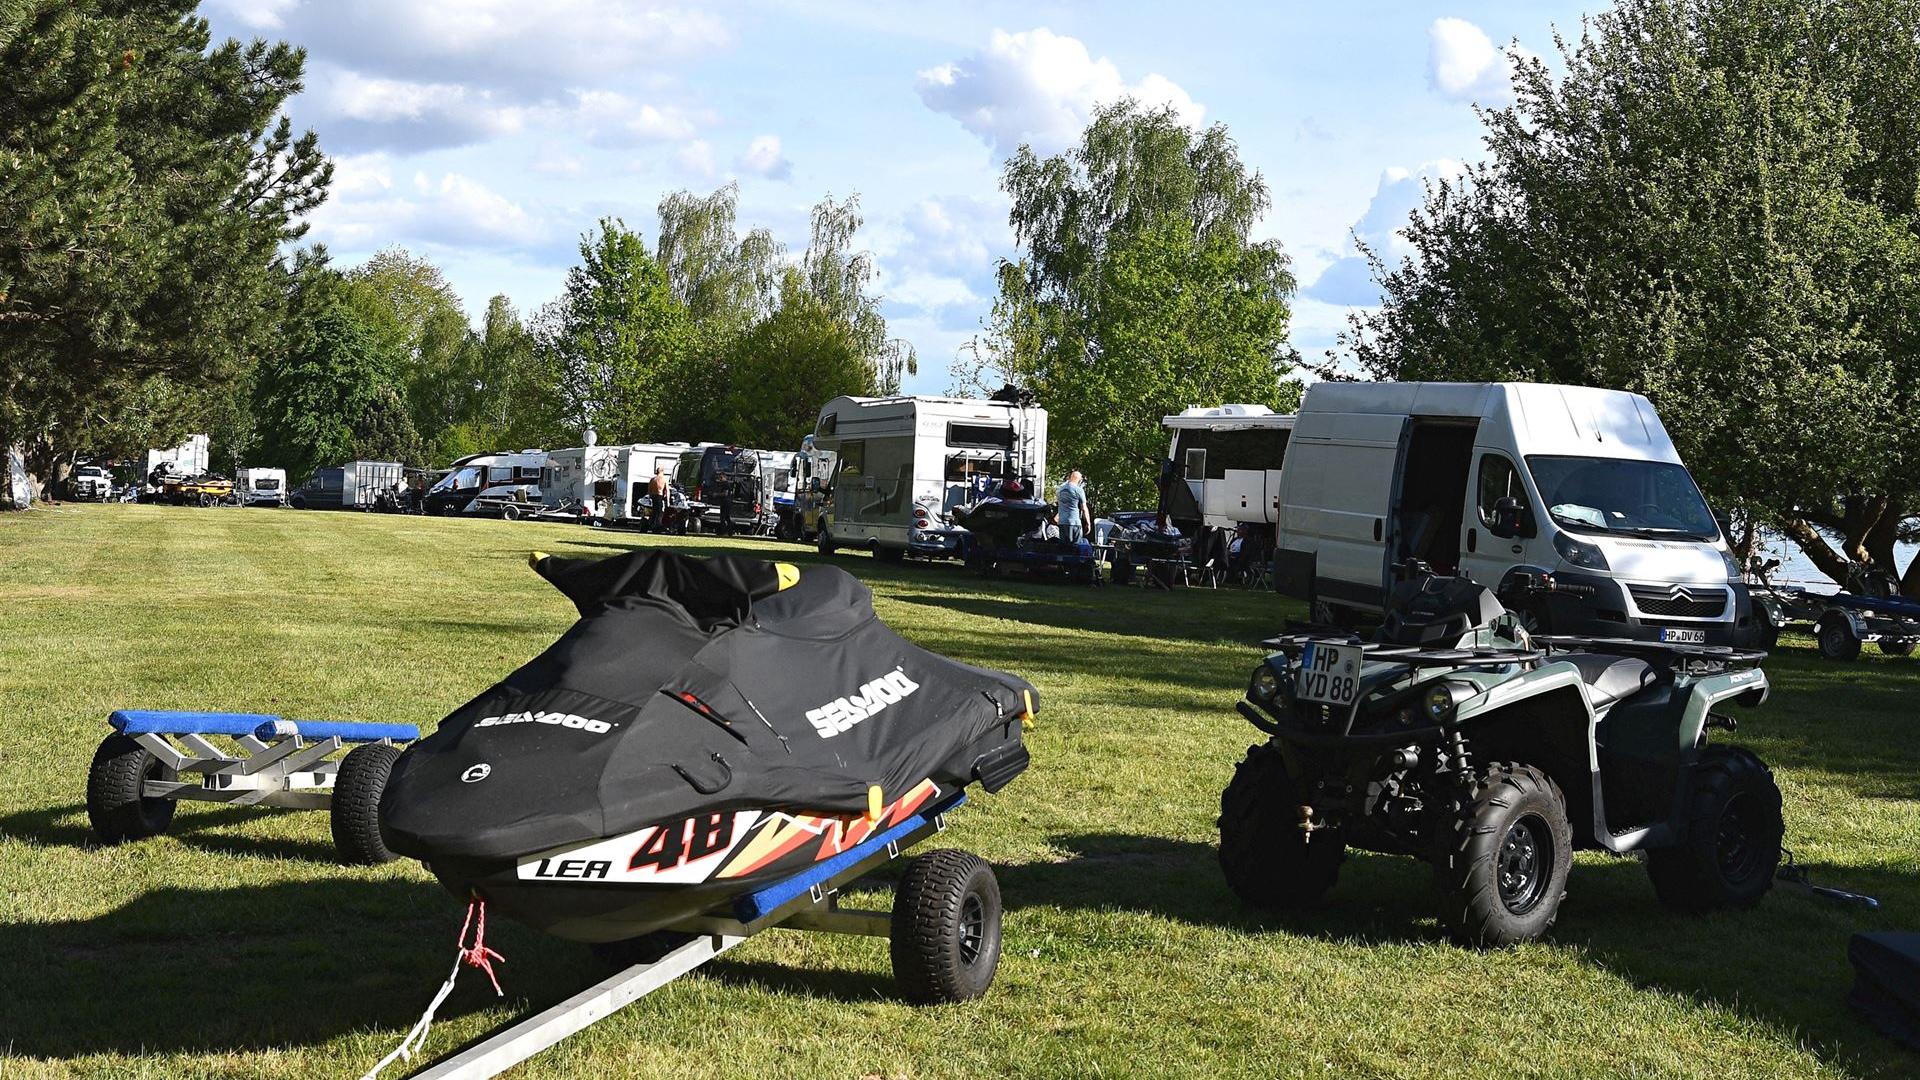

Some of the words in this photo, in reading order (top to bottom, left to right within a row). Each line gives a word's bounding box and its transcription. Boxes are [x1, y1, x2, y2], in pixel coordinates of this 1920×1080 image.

[1665, 630, 1676, 640] HP
[1681, 631, 1693, 641] DV
[1694, 631, 1704, 641] 66
[1314, 647, 1339, 672] HP
[1305, 672, 1328, 698] YD
[1330, 676, 1354, 702] 88
[626, 811, 736, 874] 48
[535, 858, 612, 878] LEA
